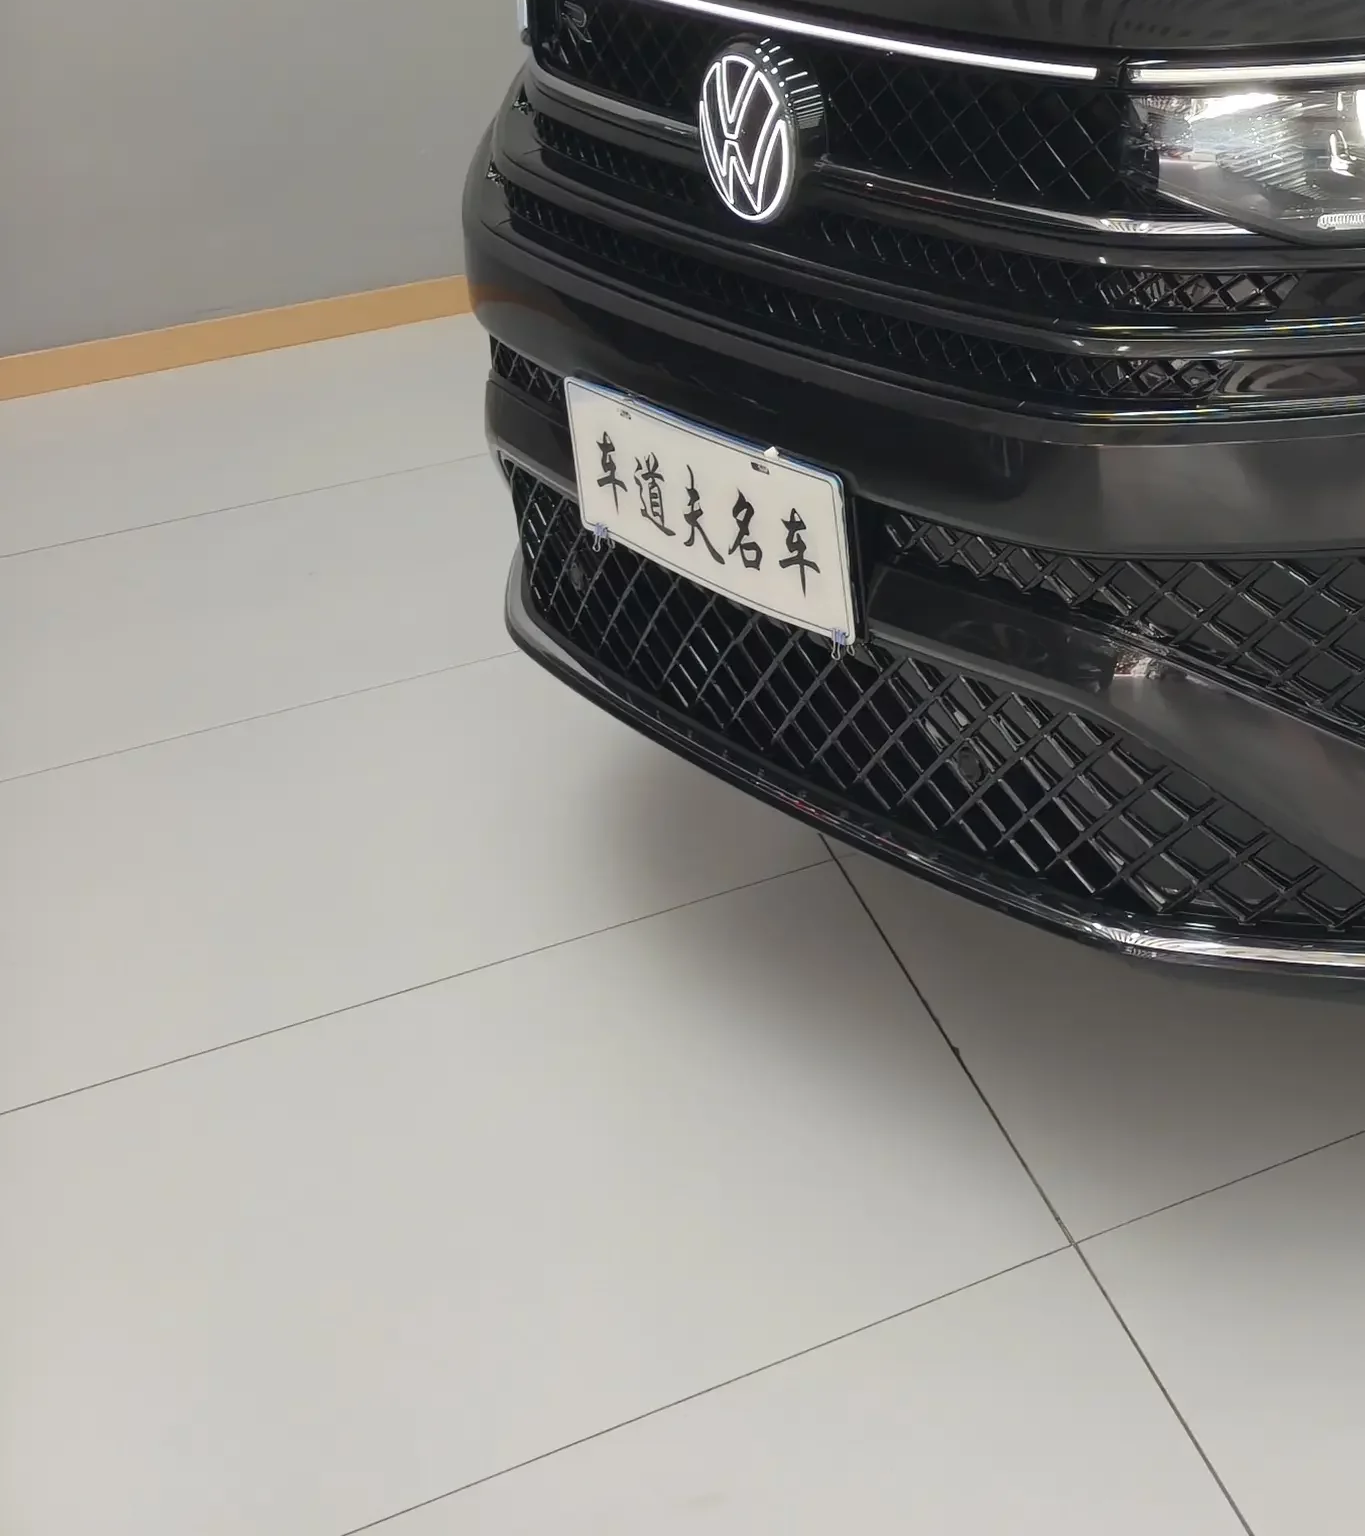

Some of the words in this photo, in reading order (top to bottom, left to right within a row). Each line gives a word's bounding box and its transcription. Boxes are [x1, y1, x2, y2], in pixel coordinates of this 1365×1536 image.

[596, 431, 820, 598] 车道夫名车
